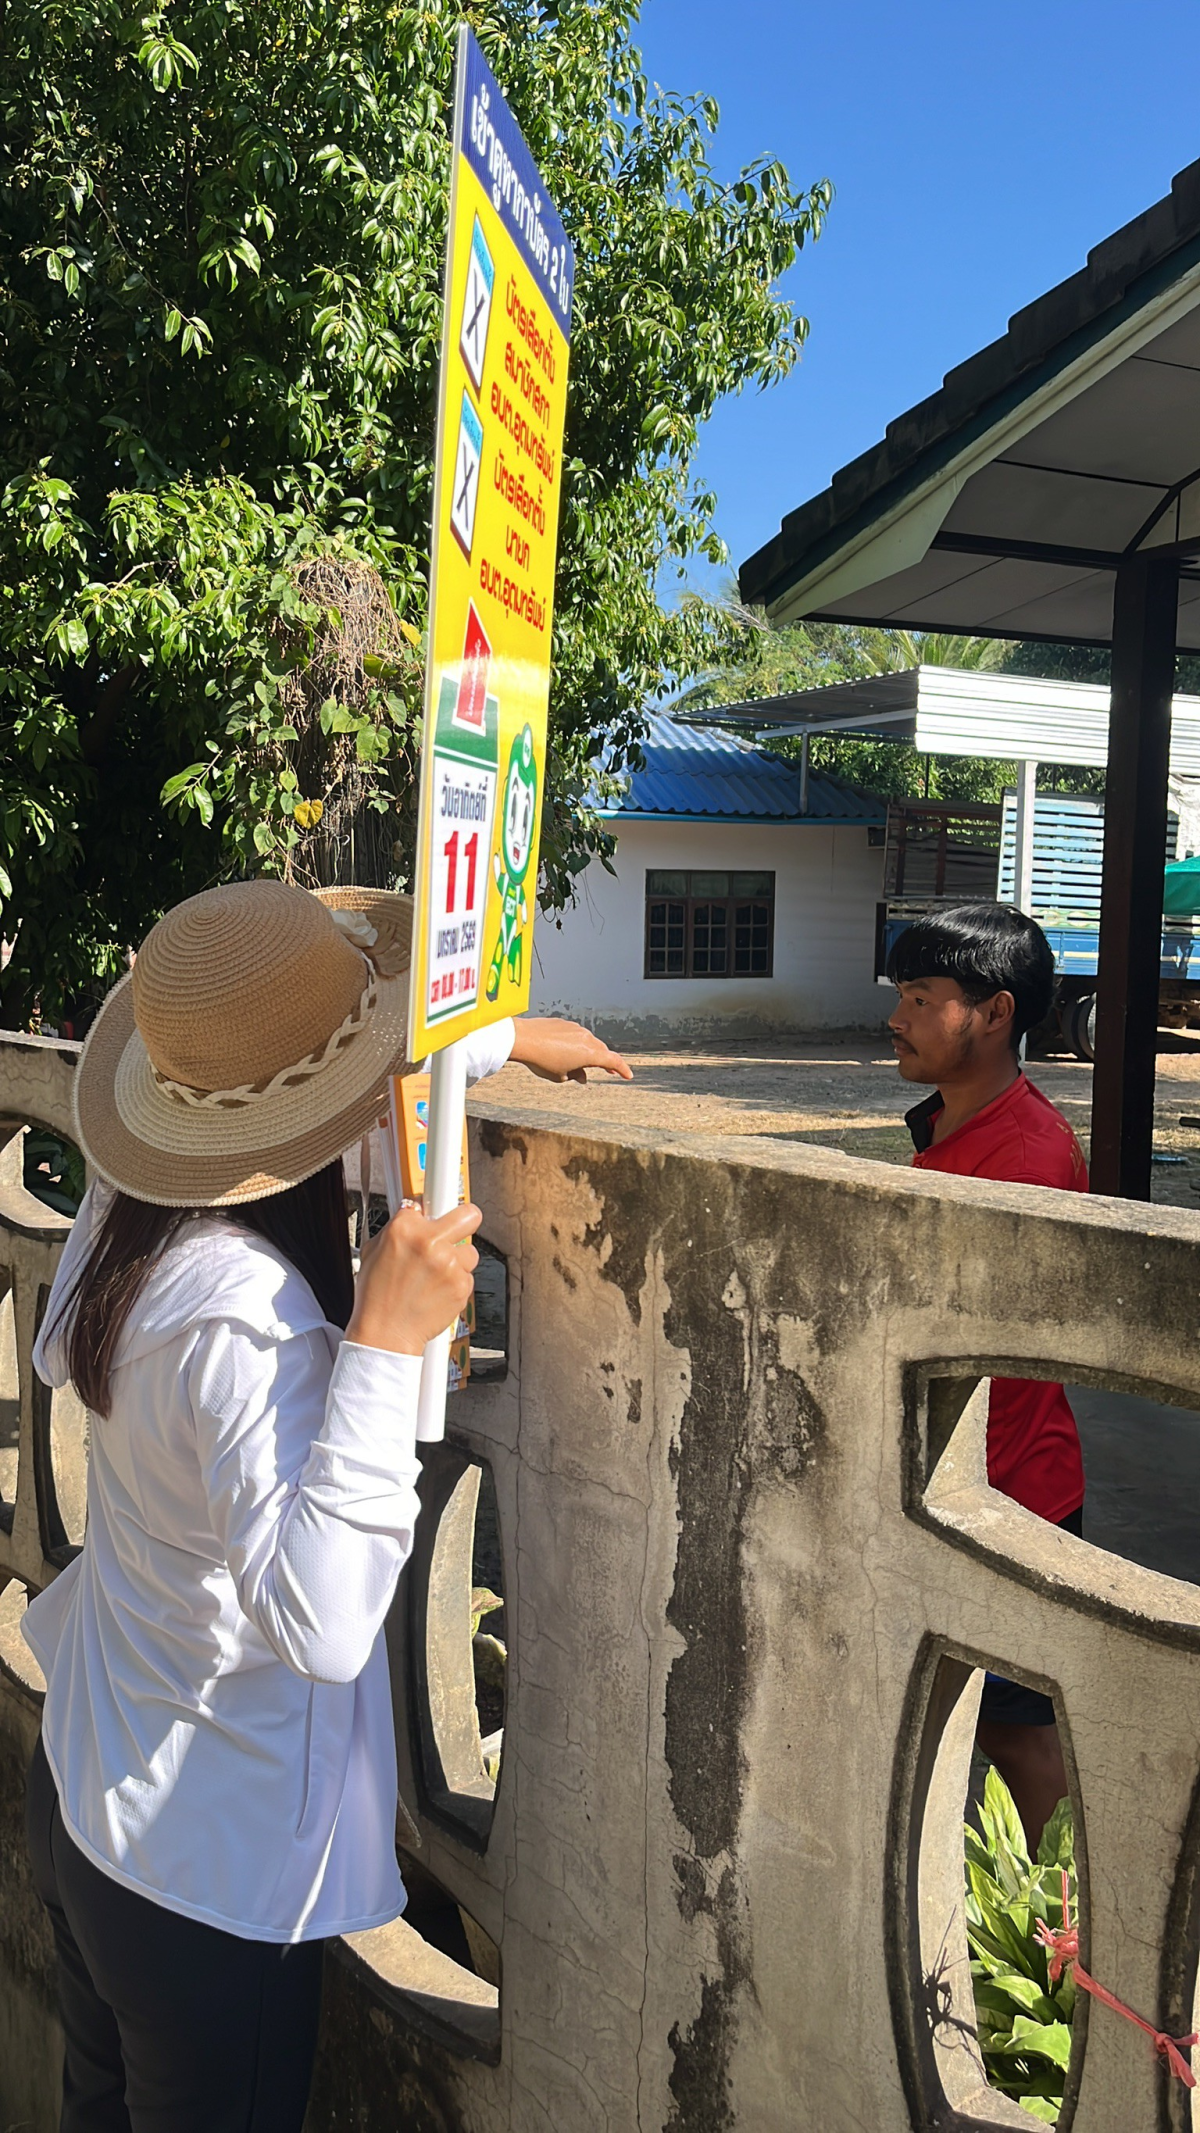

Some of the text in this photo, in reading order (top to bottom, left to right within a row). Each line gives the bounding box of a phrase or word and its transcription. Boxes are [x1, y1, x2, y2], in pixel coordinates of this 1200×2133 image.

[470, 83, 549, 276] เข้าคูหากาบัตร
[551, 247, 559, 293] 2
[559, 245, 570, 314] ใบ
[505, 274, 555, 385] บัตรเลือกตั้ง
[504, 341, 550, 430] สมาชิกสภา
[491, 381, 555, 484] อบต.อุดมทรัพย์
[494, 449, 545, 536] บัตรเลือกตั้ง
[506, 525, 530, 572] นายก
[480, 558, 546, 632] อบต.อุดมทรัพย์
[441, 774, 489, 822] วันอาทิตย์ที่
[444, 831, 478, 913] 11
